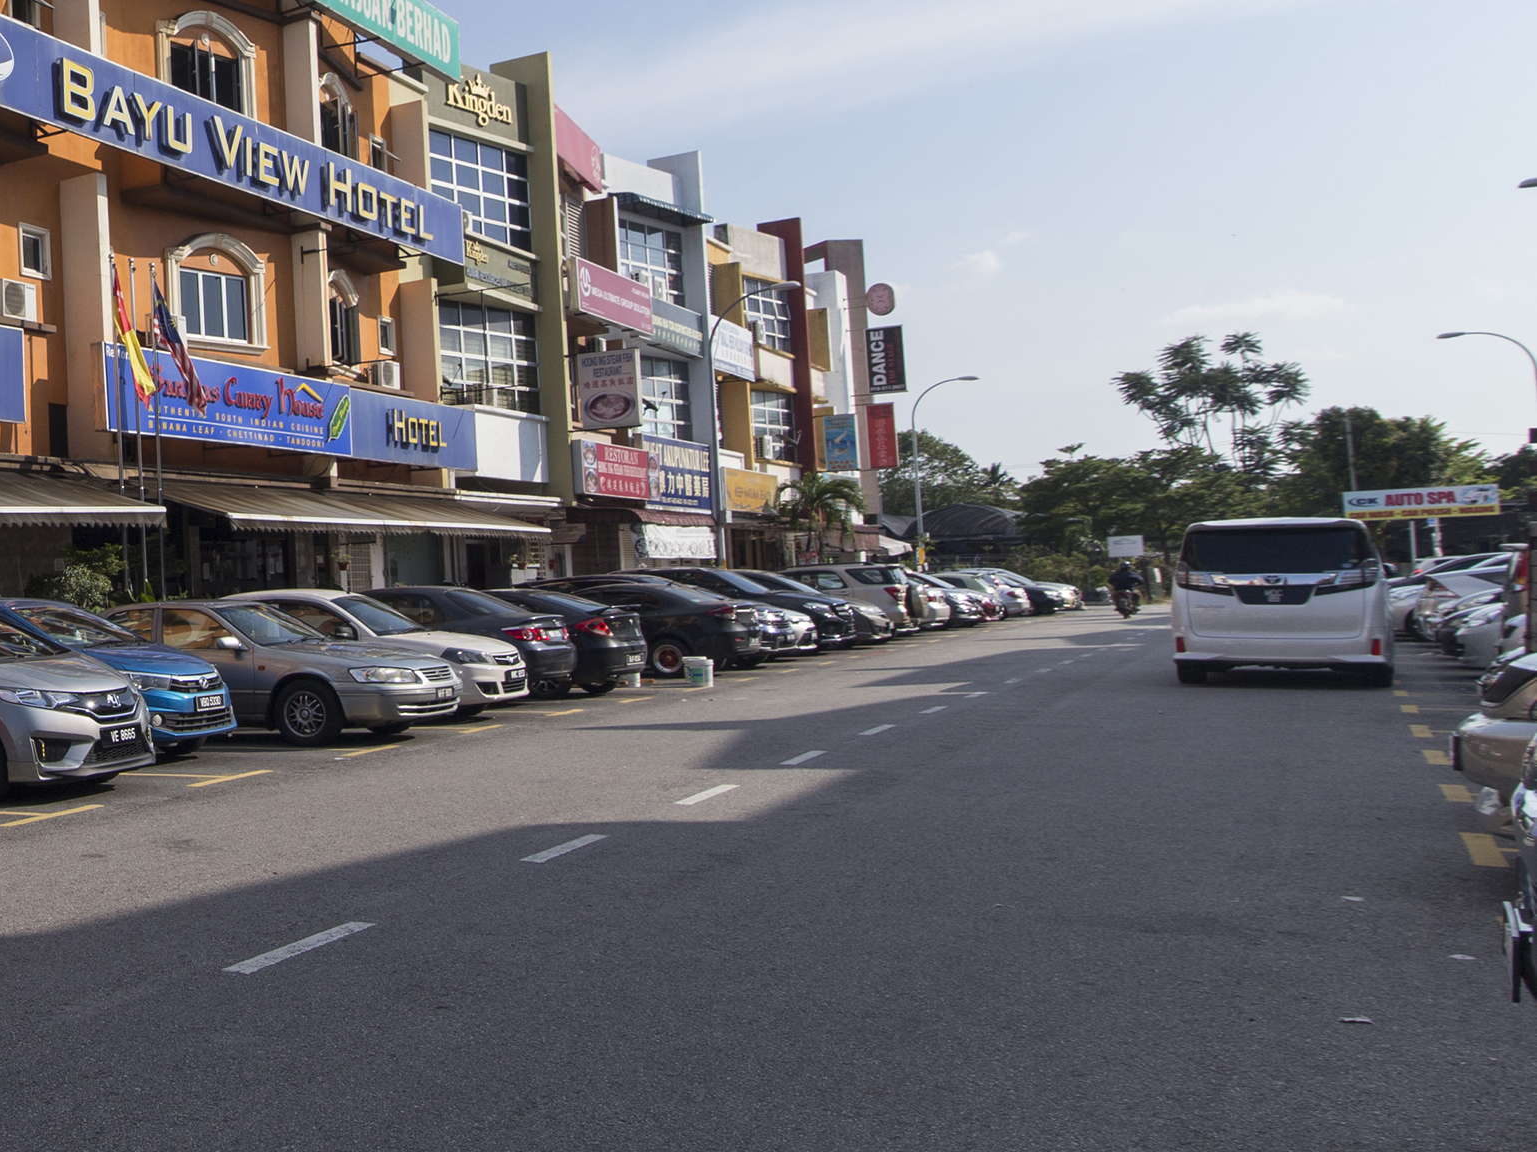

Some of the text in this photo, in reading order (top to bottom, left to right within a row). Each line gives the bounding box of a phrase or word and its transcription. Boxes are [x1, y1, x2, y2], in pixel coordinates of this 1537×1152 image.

[447, 82, 513, 127] Kingden
[61, 57, 434, 242] BAYU VIEW HOTEL
[869, 330, 888, 386] DANCE
[593, 365, 622, 378] RESTAURANT
[215, 412, 243, 424] SOUTH
[250, 417, 284, 429] INDIAN
[291, 423, 324, 435] CUISINE
[392, 408, 447, 448] HOTEL
[192, 425, 215, 436] LEAF
[227, 429, 275, 443] CHETTINAD
[286, 436, 325, 449] TANDOORI
[604, 446, 638, 465] RESTORAN
[1384, 492, 1424, 507] AUTO
[1426, 491, 1456, 505] SPA
